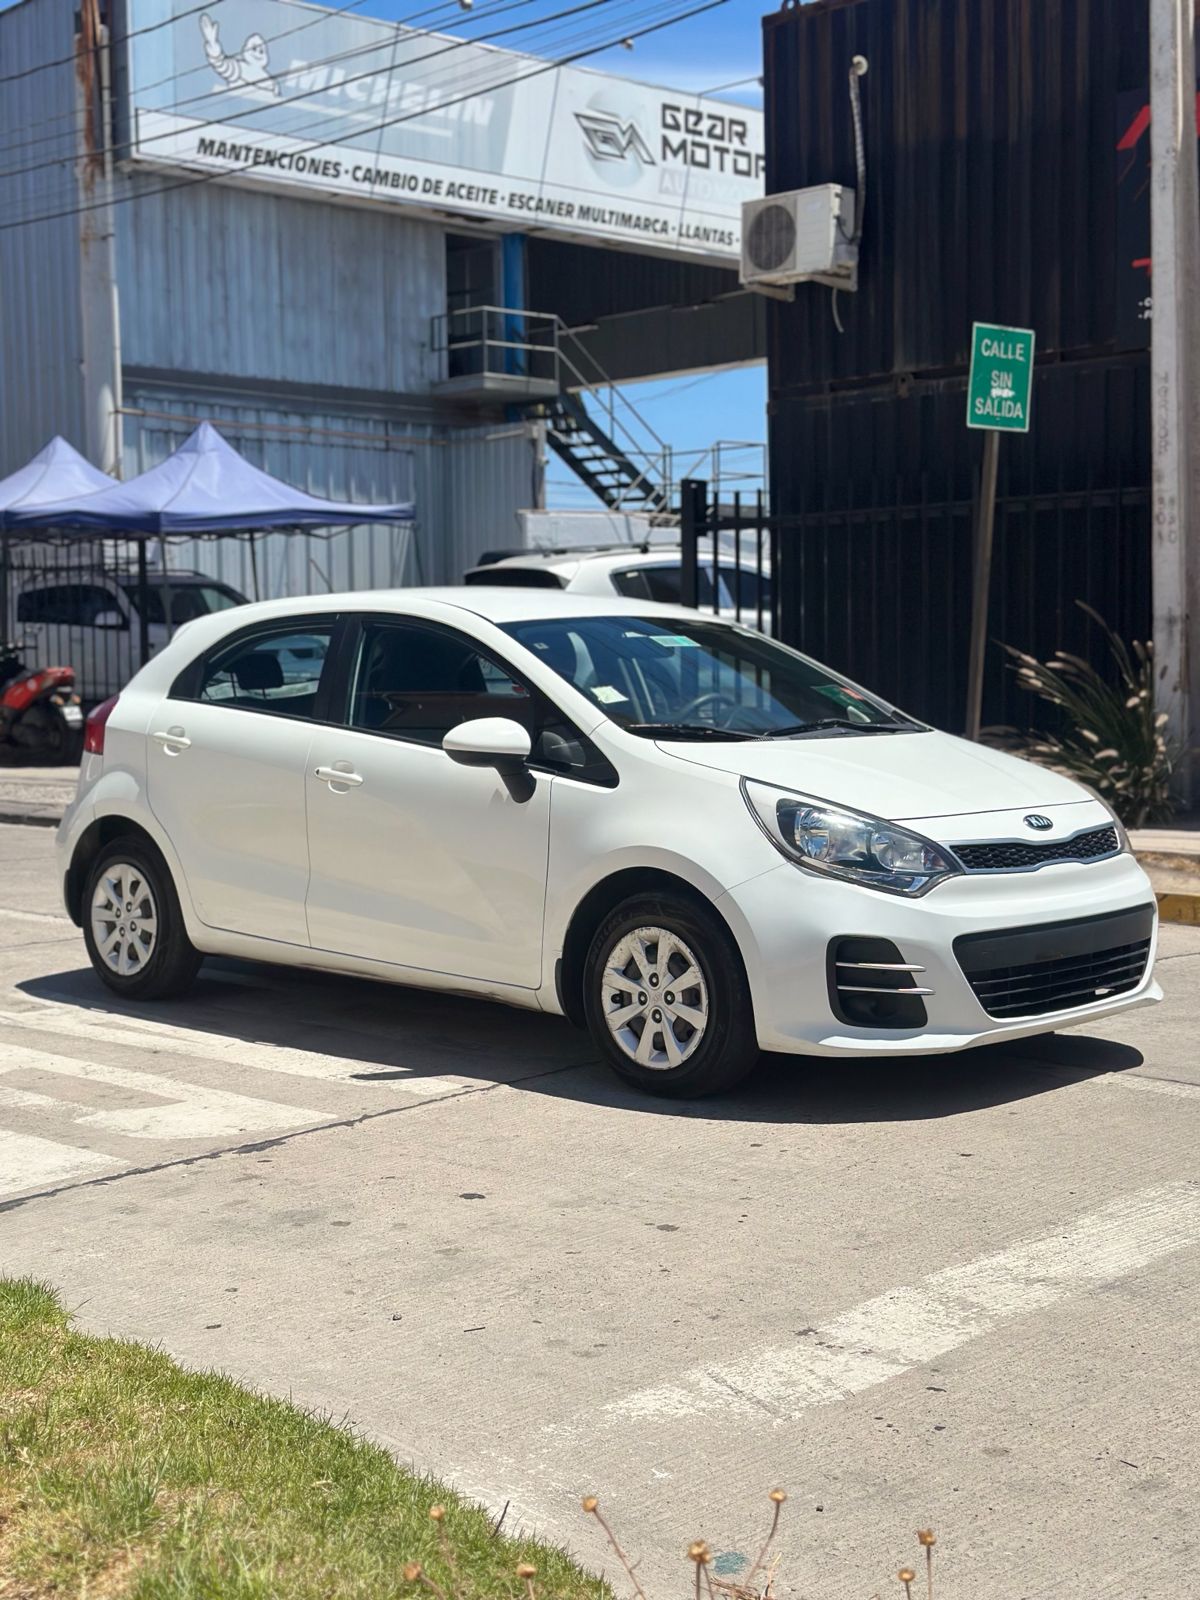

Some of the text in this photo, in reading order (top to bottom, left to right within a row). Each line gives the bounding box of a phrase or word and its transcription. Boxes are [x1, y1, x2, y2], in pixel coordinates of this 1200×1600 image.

[286, 60, 494, 126] MICHELIN
[197, 137, 733, 245] MANTENCIONES CAMBIO DE ACEITE ESCANER MULTIMARCA LLANTAS
[981, 338, 1025, 362] CALLE
[991, 370, 1012, 388] SIN
[975, 396, 1023, 419] SALIDA
[1026, 816, 1053, 827] KIA
